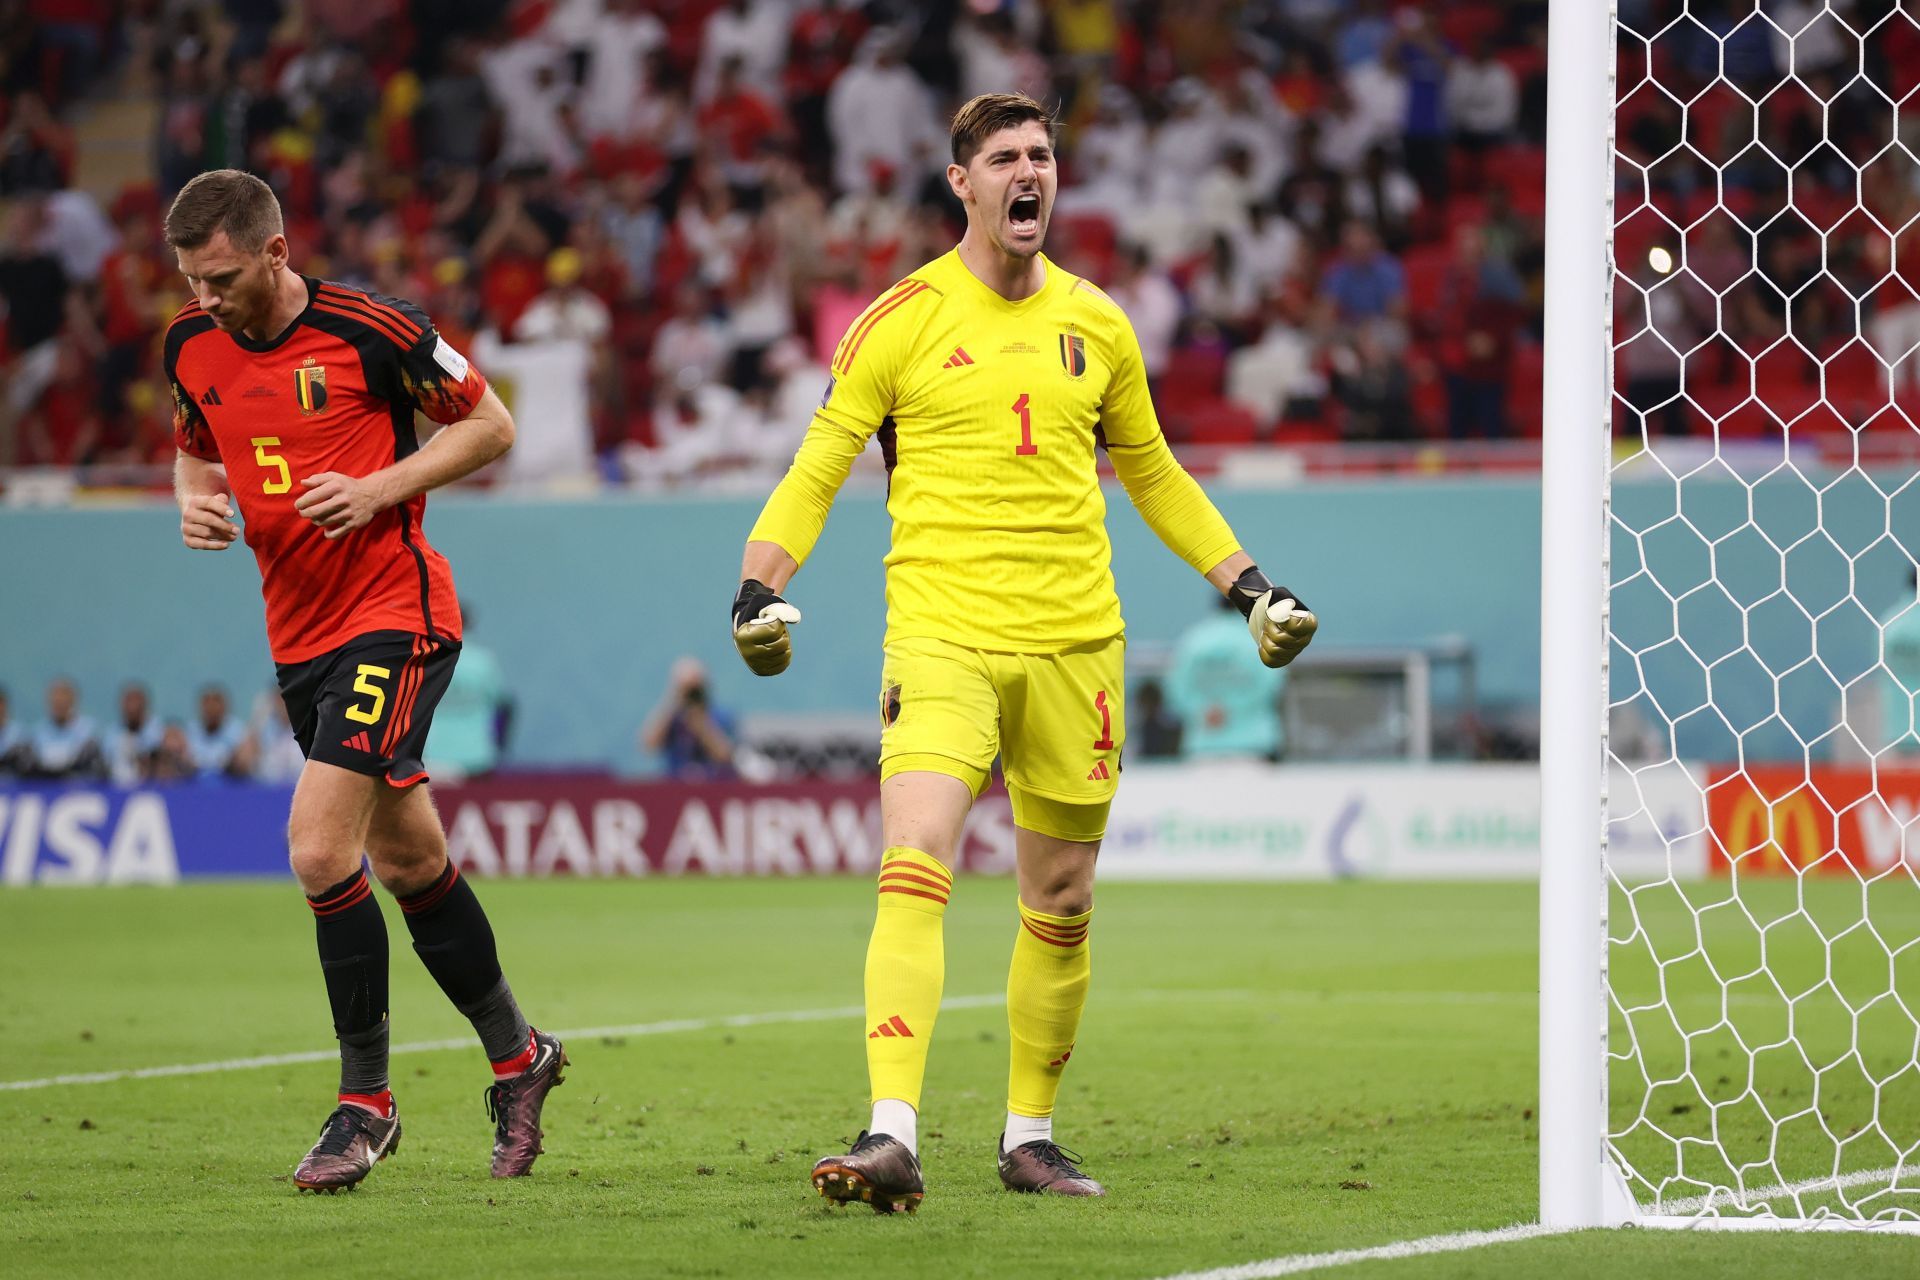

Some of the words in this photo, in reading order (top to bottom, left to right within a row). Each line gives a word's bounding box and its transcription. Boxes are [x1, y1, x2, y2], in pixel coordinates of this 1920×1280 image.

[1011, 393, 1038, 456] 1
[251, 436, 293, 495] 5
[344, 663, 391, 726] 5
[1093, 690, 1114, 751] 1
[0, 791, 181, 886] ISA
[447, 799, 649, 876] ATAR
[661, 797, 1017, 876] AIRWS
